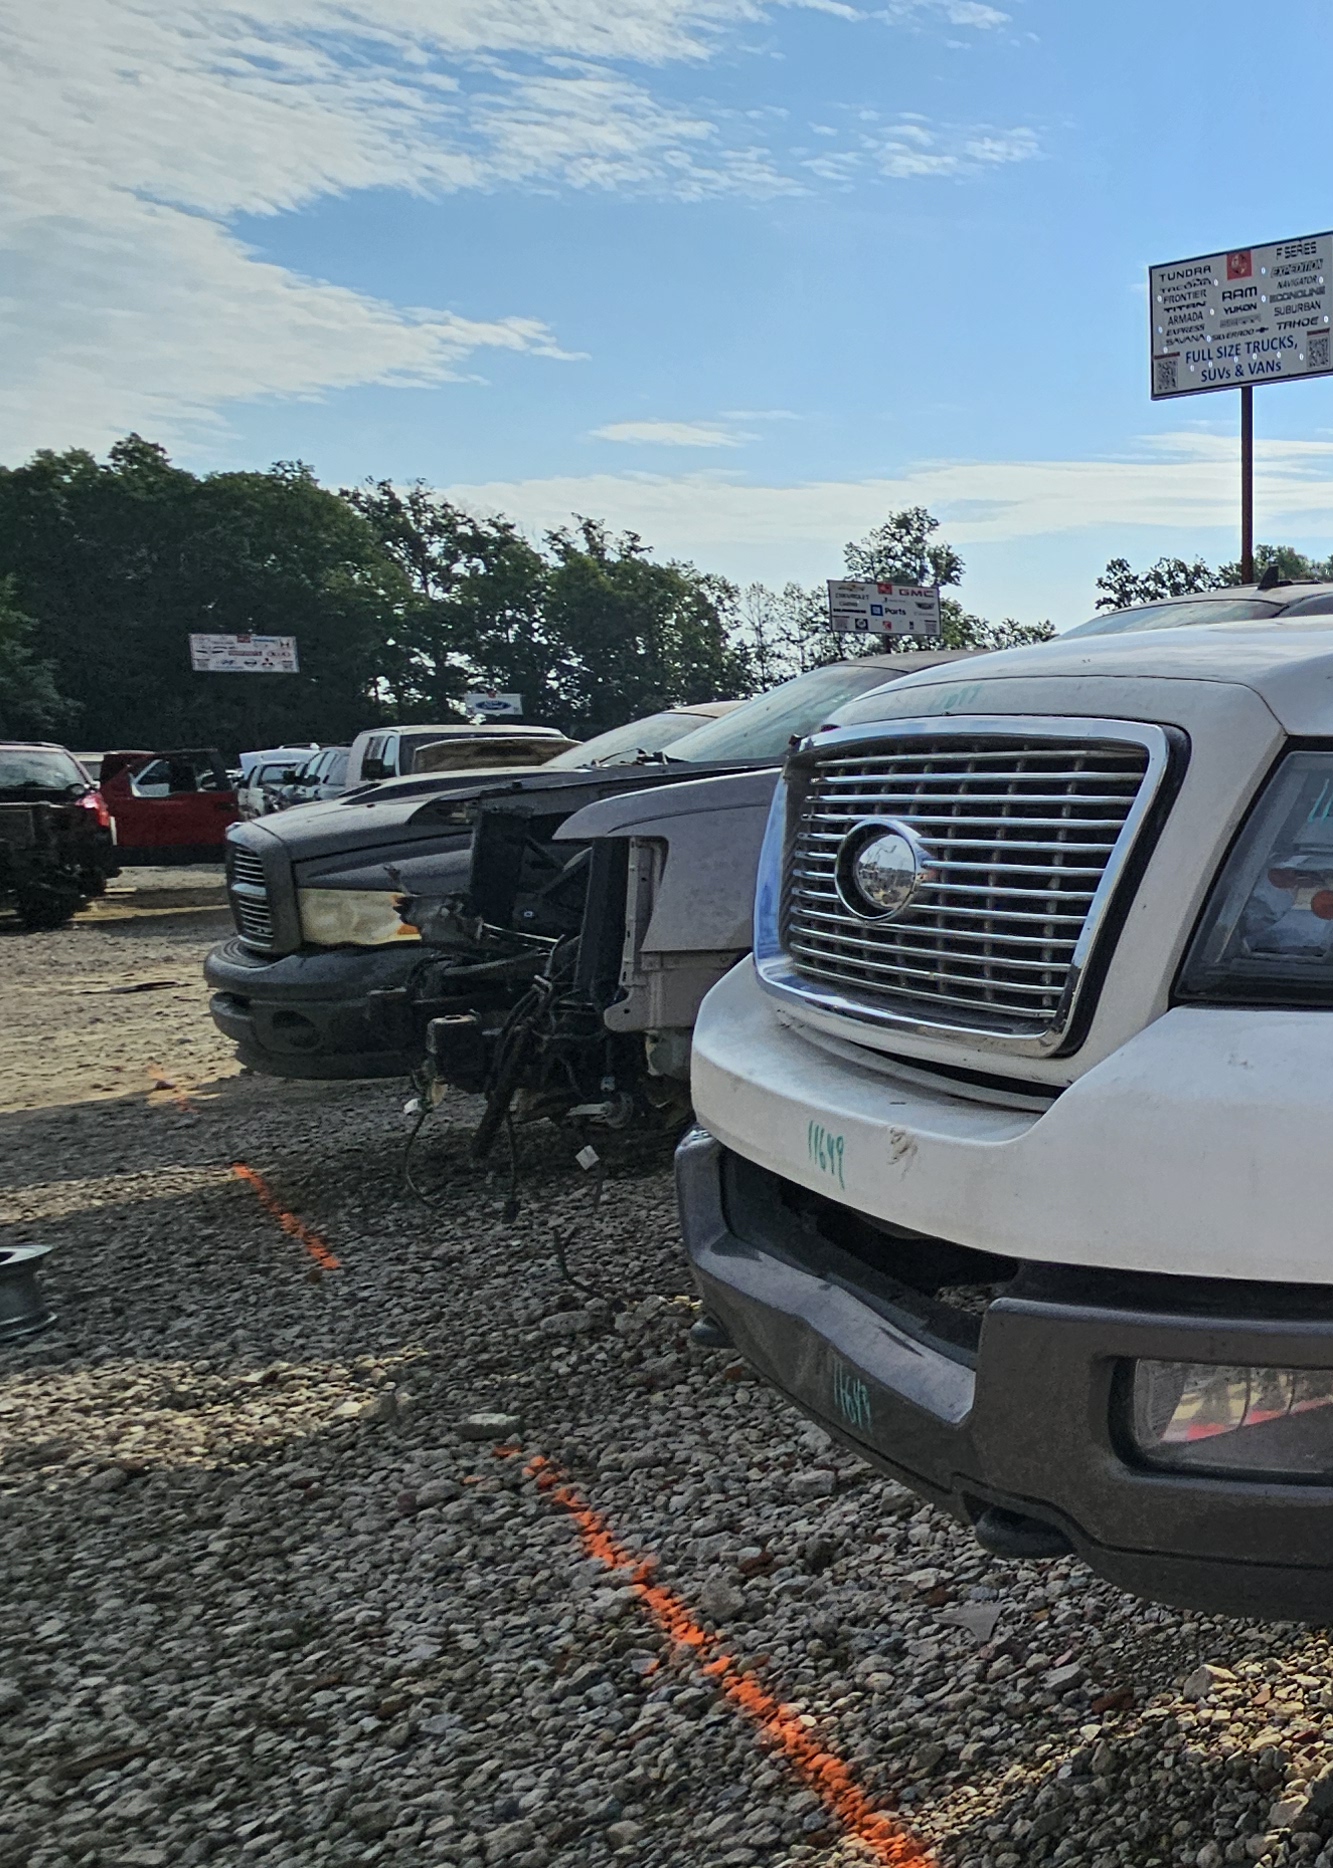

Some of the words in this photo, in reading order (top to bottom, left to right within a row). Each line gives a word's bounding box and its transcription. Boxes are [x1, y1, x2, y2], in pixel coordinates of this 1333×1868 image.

[1159, 265, 1212, 282] TUNDRA
[1161, 277, 1212, 293] TACOMA
[1277, 275, 1318, 290] NAVIGATOR
[1164, 289, 1207, 304] FRONTIER
[1222, 286, 1257, 302] RAM
[1163, 301, 1207, 313] TITAN
[1223, 303, 1257, 315] YUKON
[1274, 301, 1321, 317] SUBURBAN
[1168, 311, 1204, 326] ARMADA
[1277, 316, 1319, 331] TAHOE
[1166, 323, 1205, 337] EXPRESS
[1185, 348, 1213, 364] FULL
[1216, 344, 1241, 359] SIZE
[1246, 335, 1298, 354] TRUCKS,
[1201, 367, 1231, 382] SUVs
[1234, 364, 1244, 377] &
[1248, 360, 1282, 375] VANs
[899, 588, 935, 598] GMC
[884, 607, 907, 616] Parts
[807, 1120, 845, 1191] 11649
